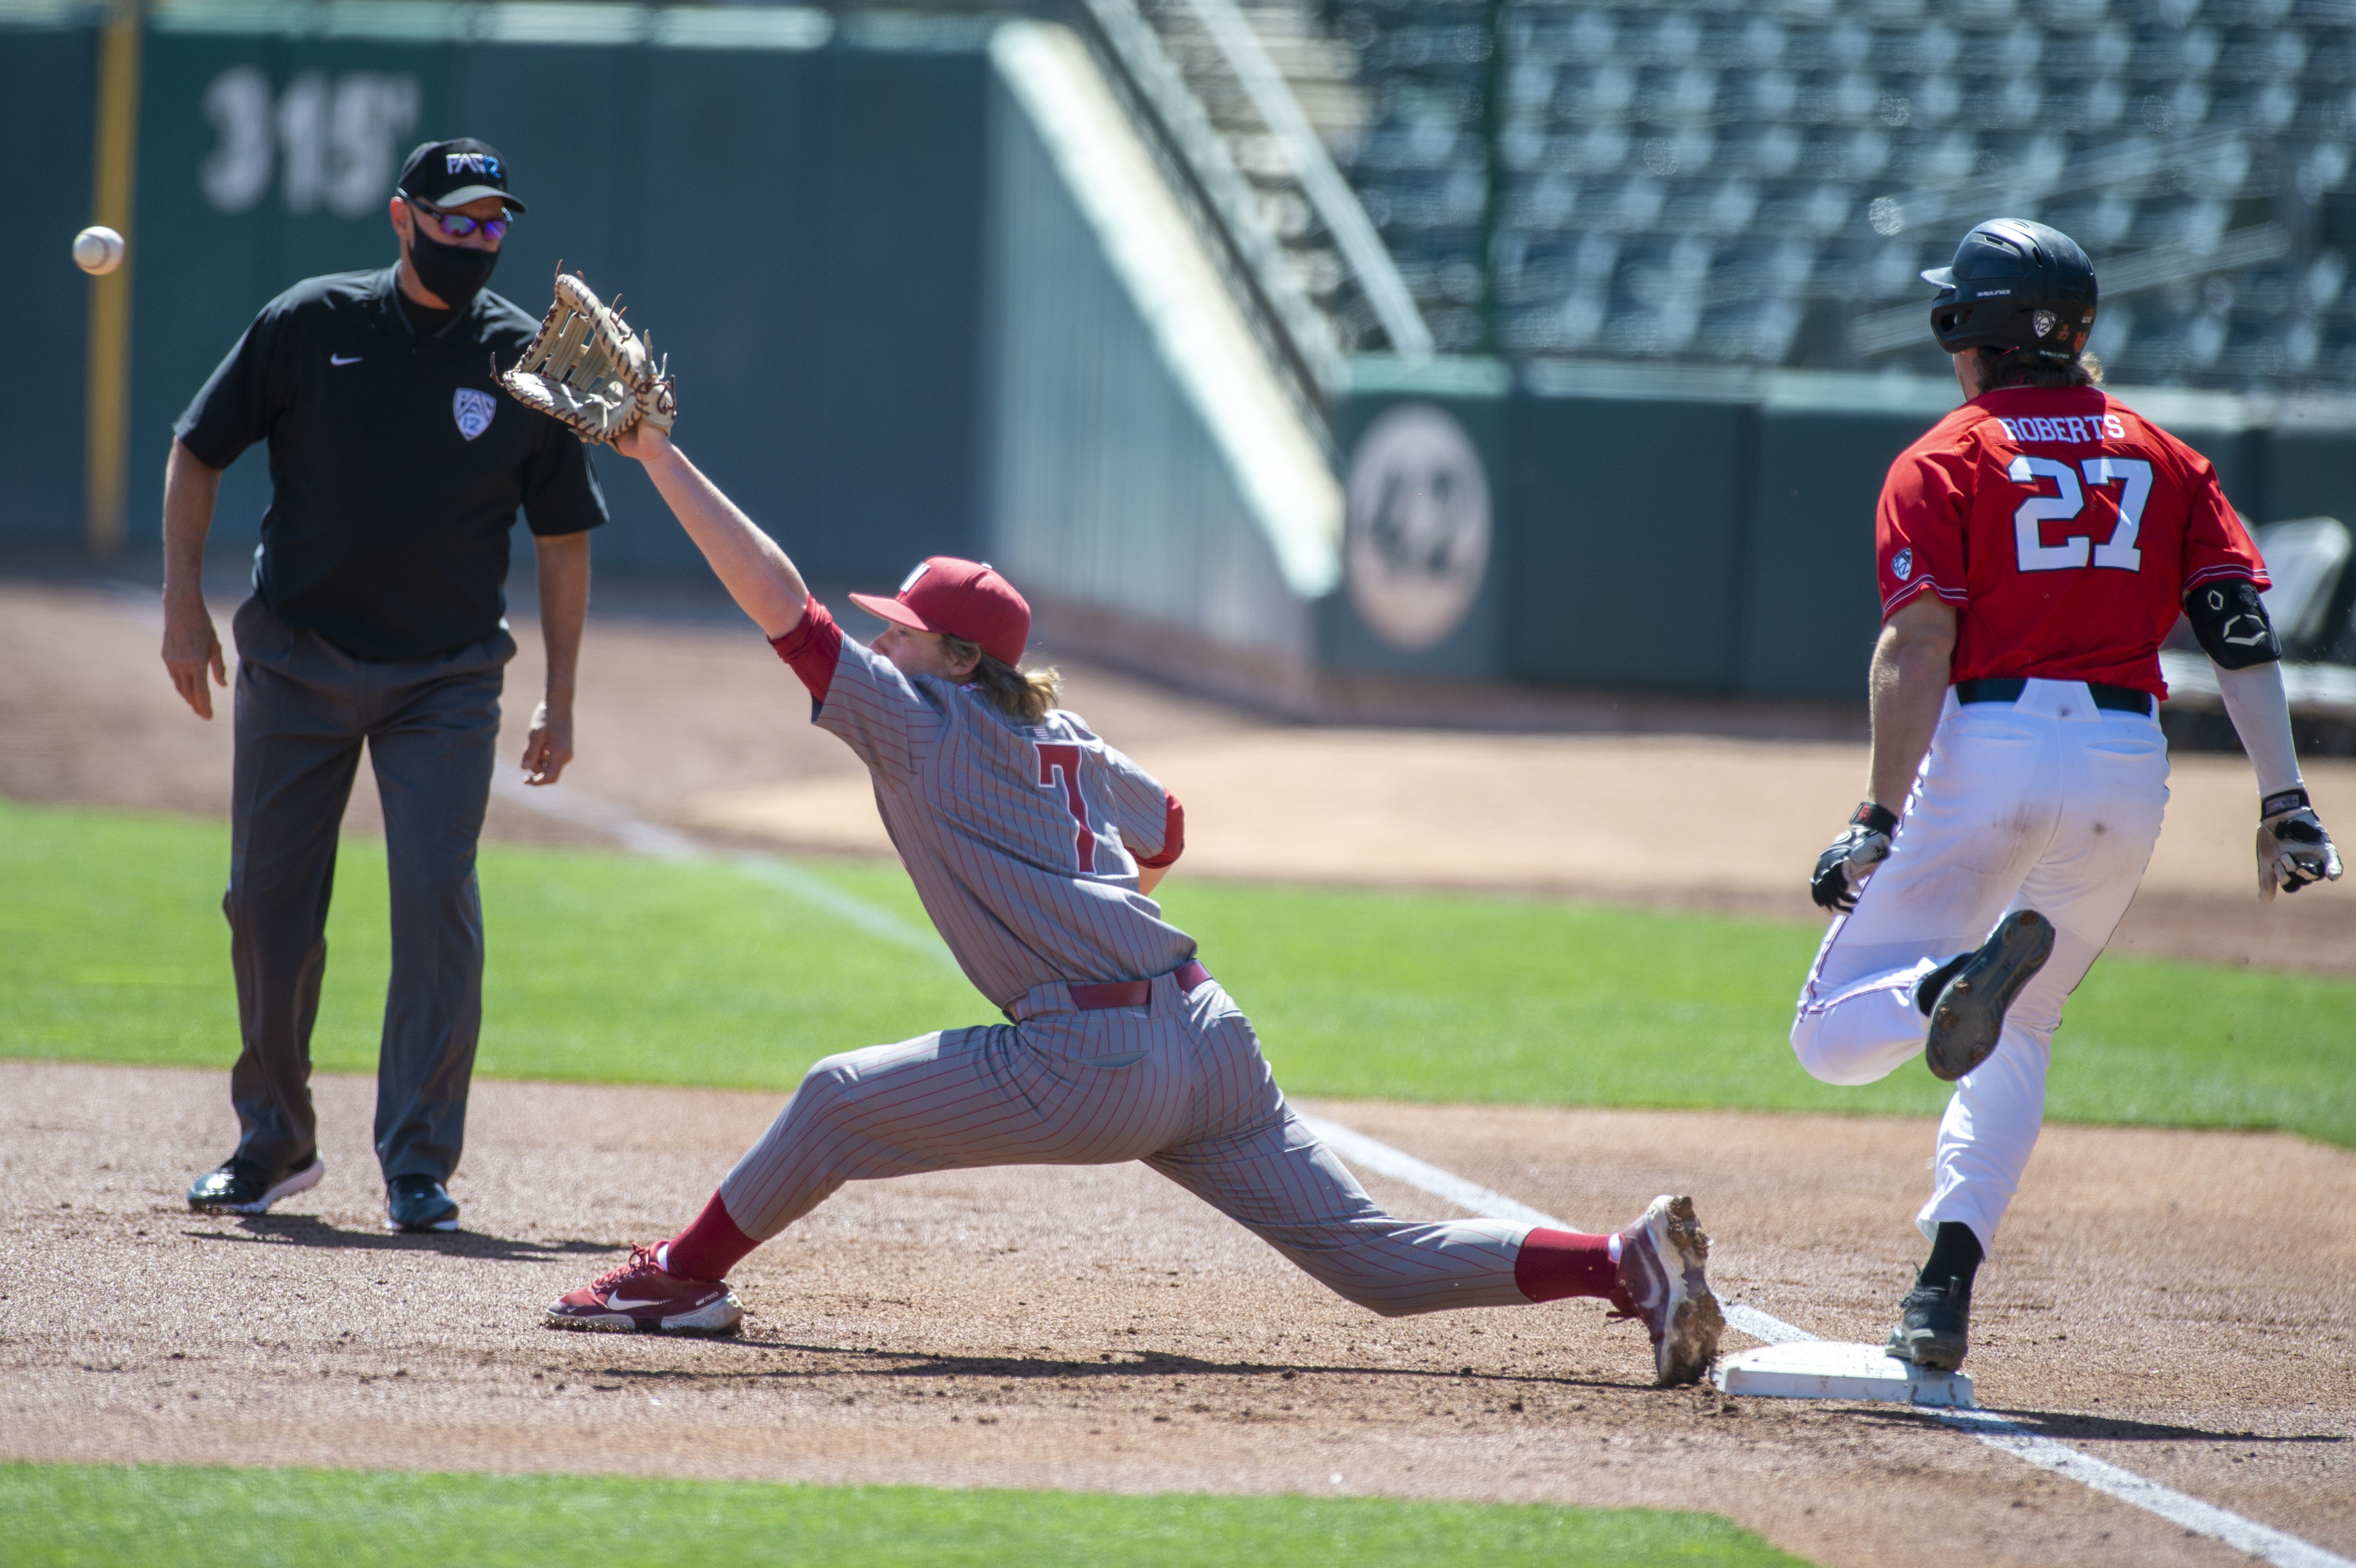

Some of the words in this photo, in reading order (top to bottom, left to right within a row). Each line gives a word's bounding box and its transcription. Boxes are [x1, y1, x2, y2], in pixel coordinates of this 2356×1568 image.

[1977, 289, 2011, 298] RAWLINGS
[2036, 311, 2057, 329] PAC
[2037, 323, 2050, 333] 12
[1998, 415, 2125, 443] ROBERTS
[2006, 455, 2154, 573] 27
[1032, 740, 1098, 874] 7
[705, 1291, 719, 1302] react
